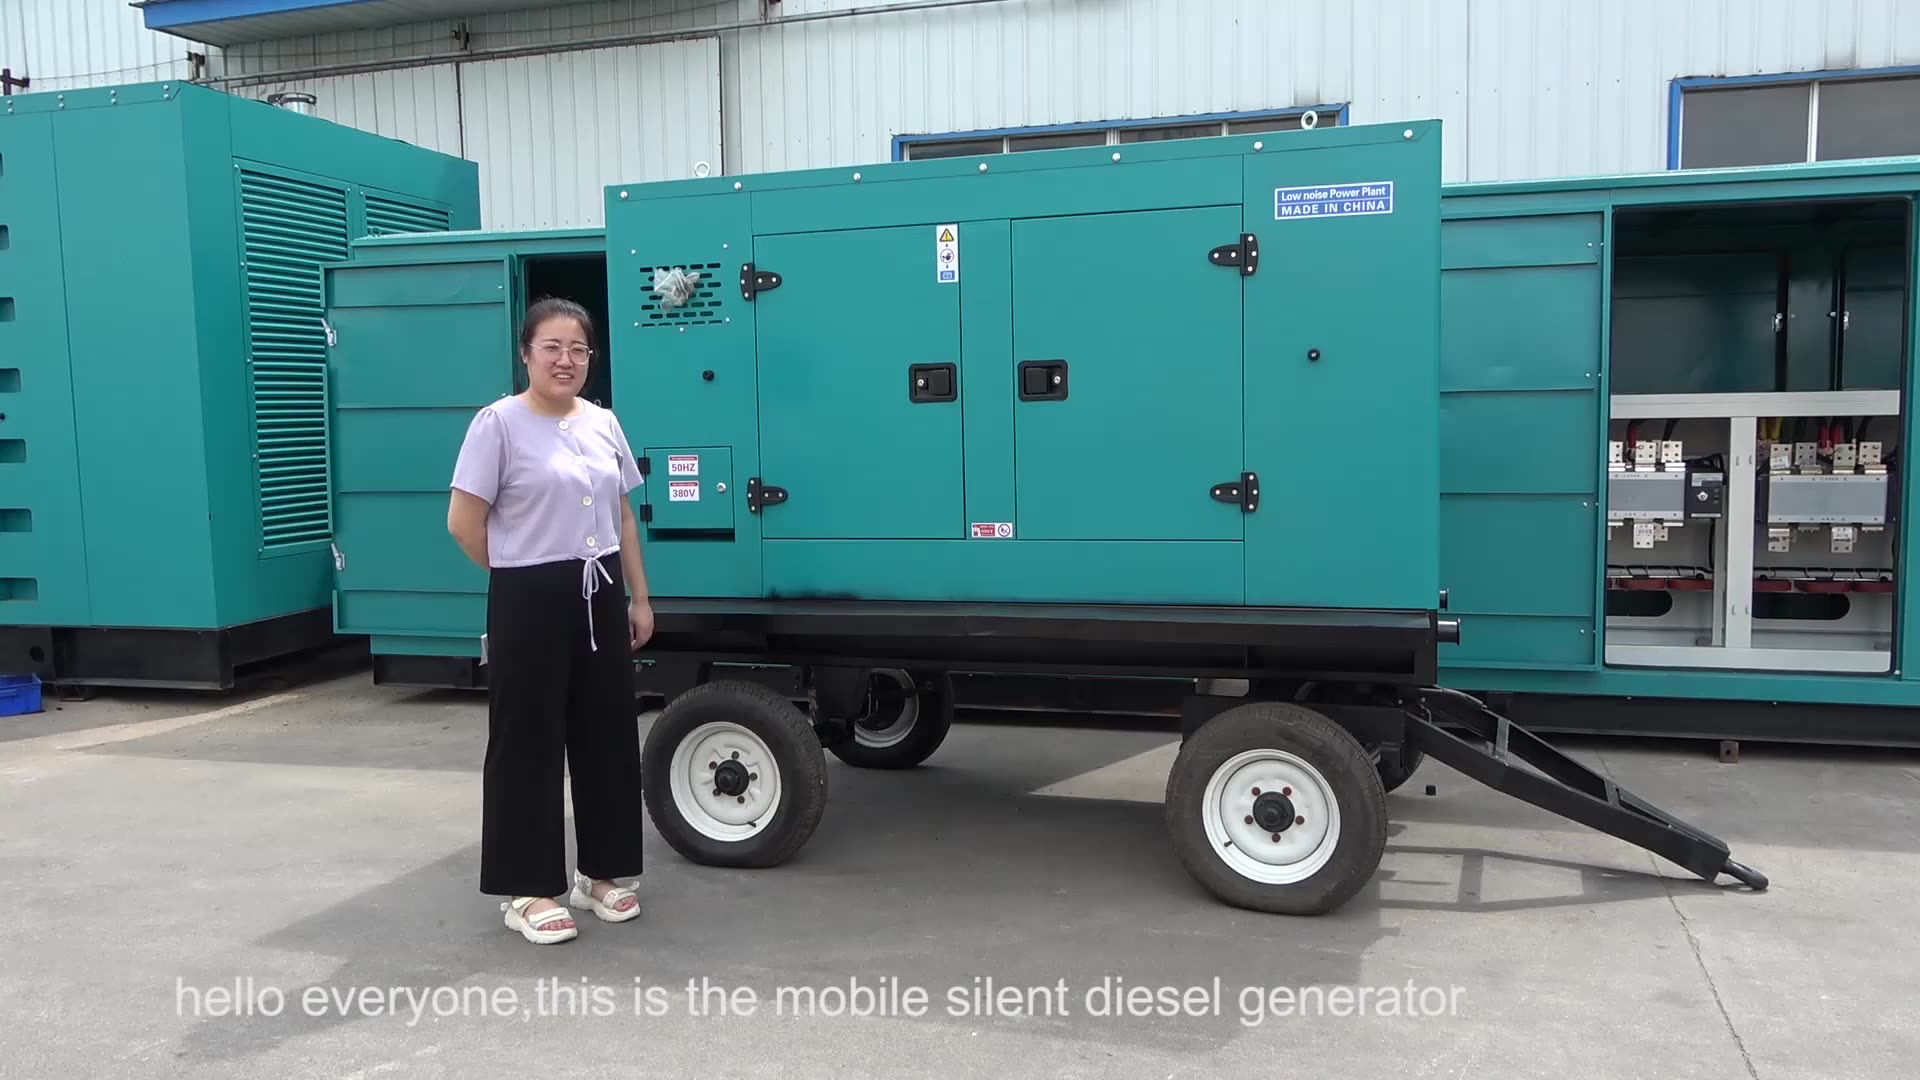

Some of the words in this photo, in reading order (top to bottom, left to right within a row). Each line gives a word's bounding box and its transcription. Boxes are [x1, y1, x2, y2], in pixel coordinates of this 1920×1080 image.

[1281, 191, 1301, 202] Low
[1303, 190, 1328, 201] noise
[1329, 188, 1360, 199] Power
[1361, 186, 1386, 197] Plant
[1281, 204, 1319, 216] MADE
[1324, 203, 1338, 213] IN
[1343, 200, 1385, 212] CHINA
[671, 463, 696, 472] 50HZ
[672, 489, 696, 498] 380V
